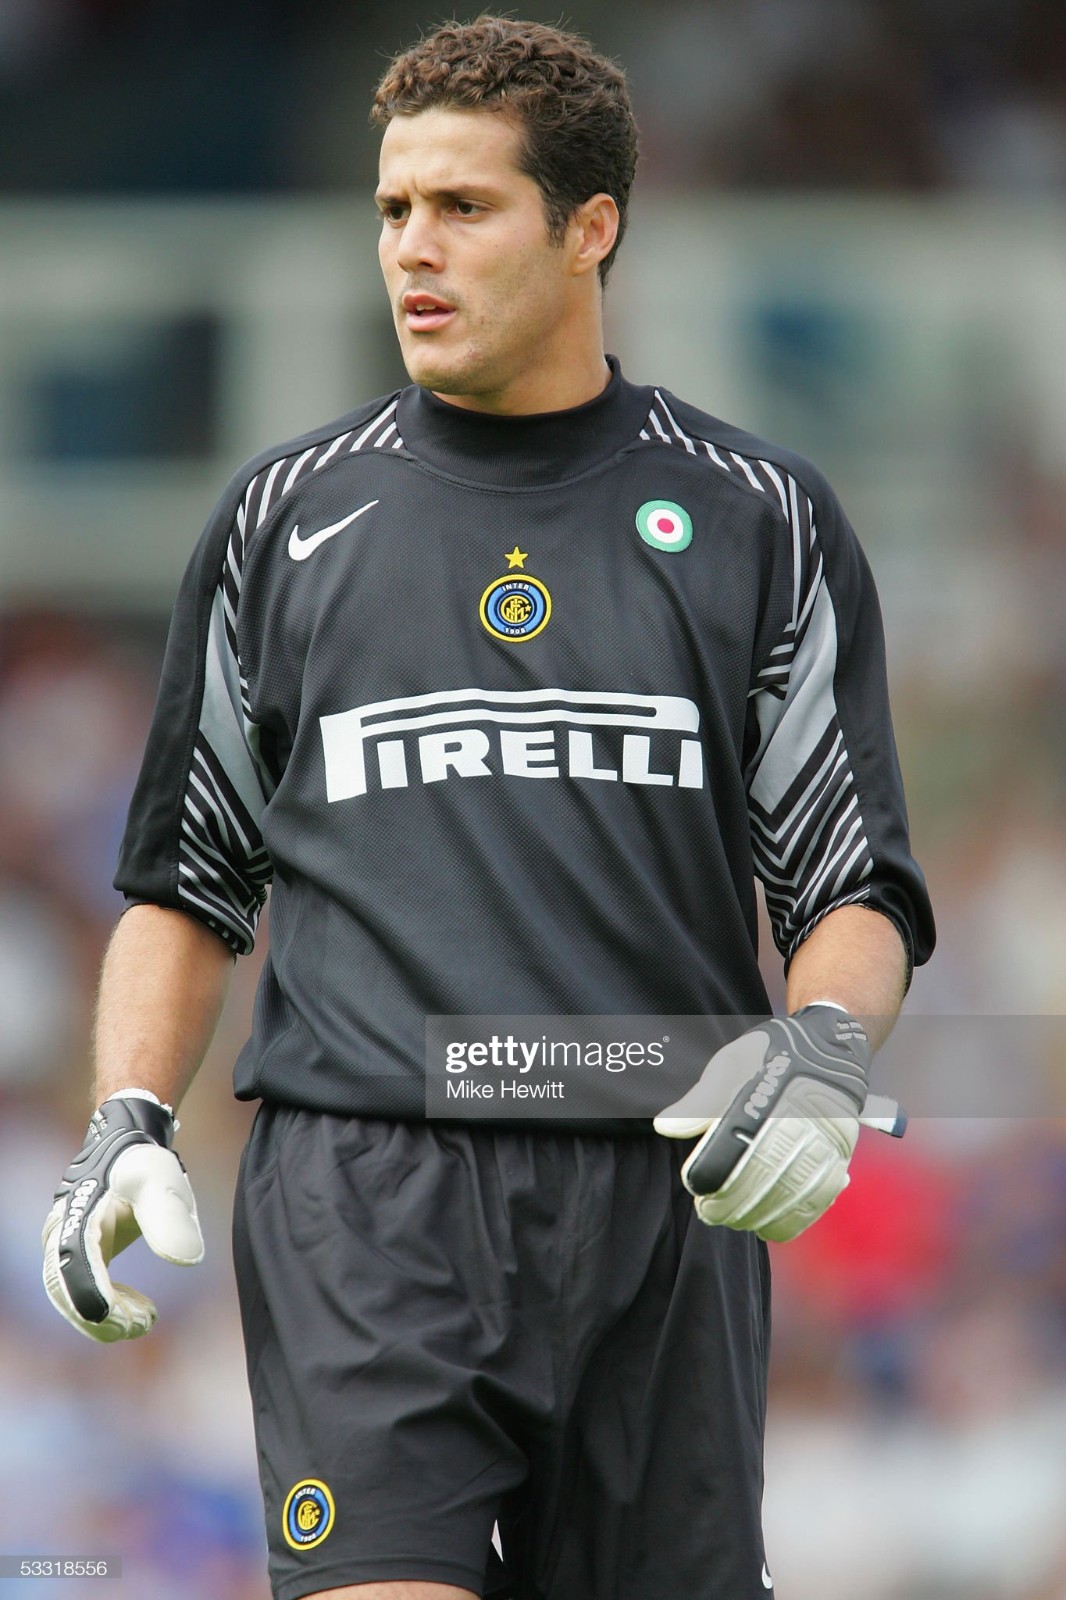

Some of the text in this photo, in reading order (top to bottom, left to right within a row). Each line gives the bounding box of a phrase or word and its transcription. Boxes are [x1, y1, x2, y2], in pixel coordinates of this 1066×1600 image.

[502, 582, 530, 592] INTER
[505, 627, 526, 635] 1908
[319, 688, 704, 803] PIRELLI
